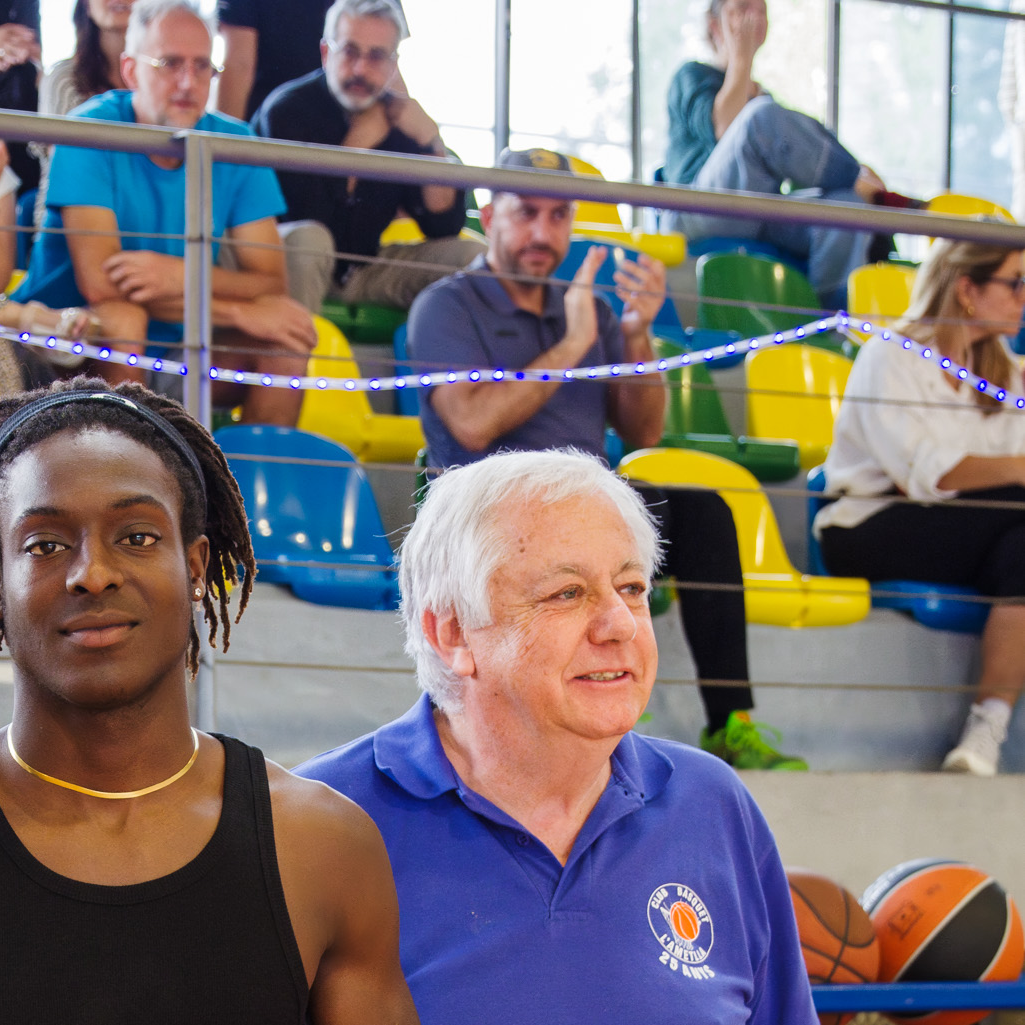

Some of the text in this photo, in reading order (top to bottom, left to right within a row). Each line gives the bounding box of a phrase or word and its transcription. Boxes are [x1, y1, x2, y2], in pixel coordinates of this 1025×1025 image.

[651, 888, 669, 909] CLUB
[658, 951, 715, 980] 25 ANYS
